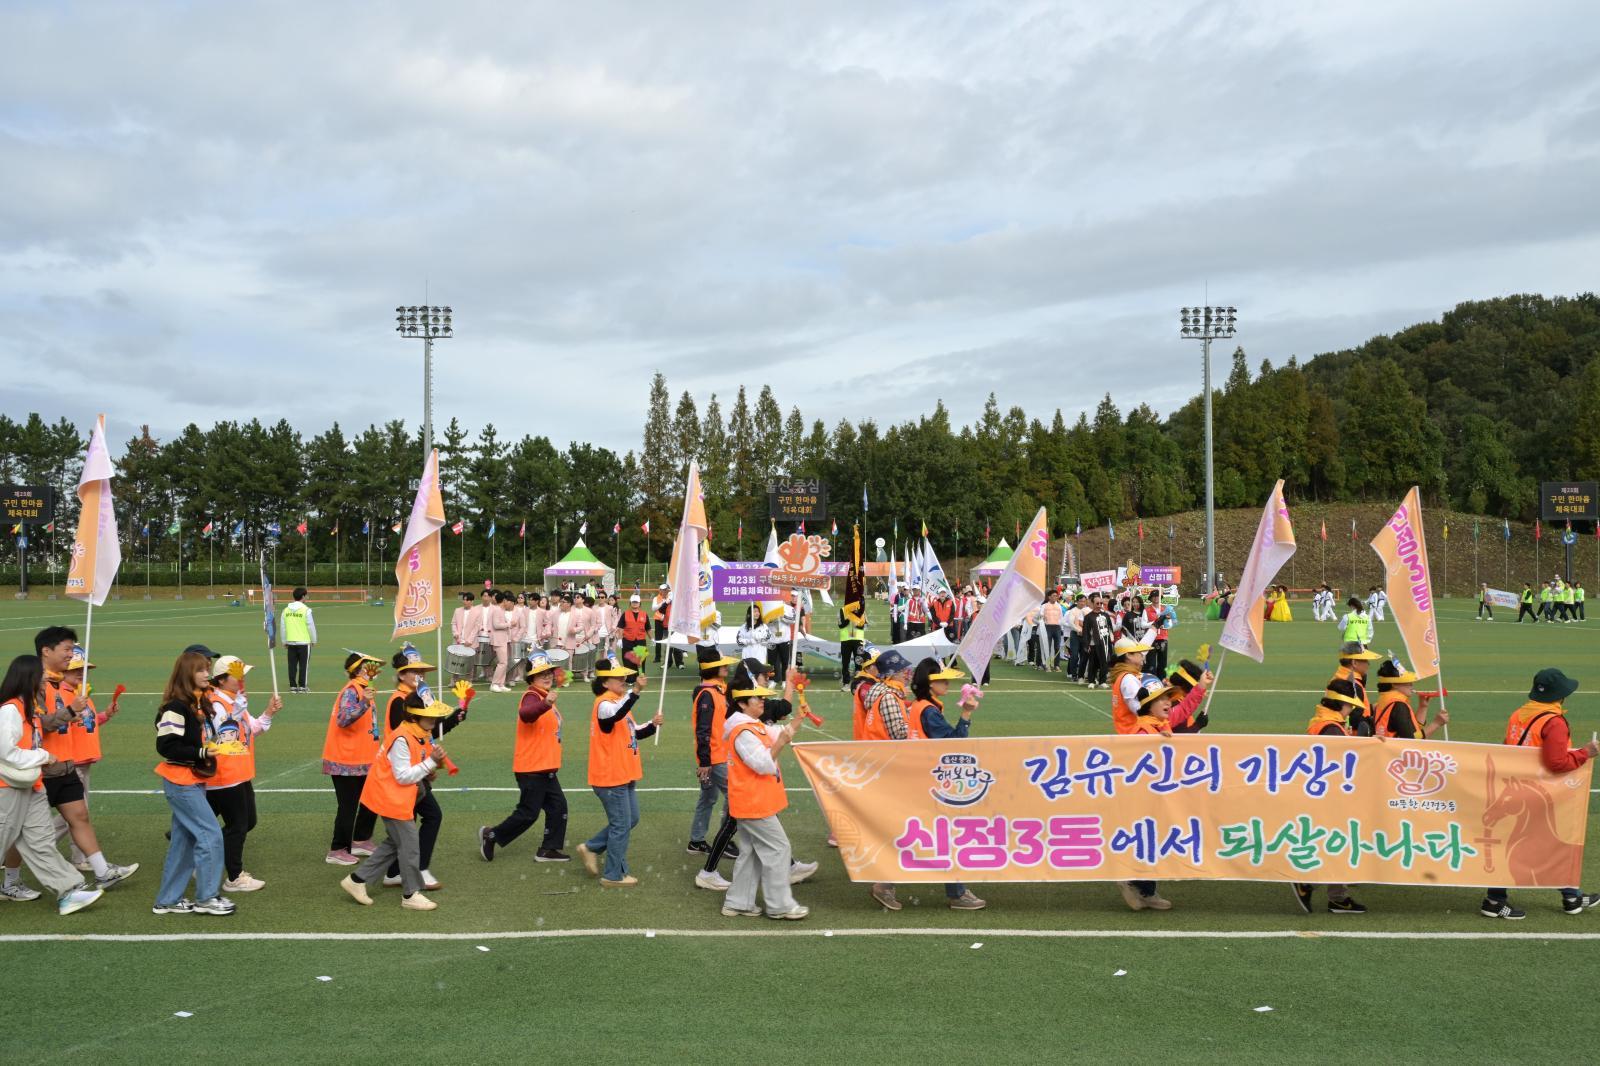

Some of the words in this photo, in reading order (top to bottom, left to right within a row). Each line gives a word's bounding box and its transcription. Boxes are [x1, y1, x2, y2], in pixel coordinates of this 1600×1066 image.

[3, 499, 18, 507] 구민
[21, 499, 43, 507] 한마음
[796, 496, 816, 504] 한마음
[8, 509, 38, 517] 체육대회
[728, 575, 756, 584] 제23회
[723, 586, 779, 596] 한마음체육대회
[1025, 746, 1221, 799] 김유신의
[1239, 745, 1357, 796] 기상!
[1389, 799, 1418, 809] 따뜻한
[1421, 800, 1456, 812] 신정3동
[1218, 816, 1476, 870] 되살아나다
